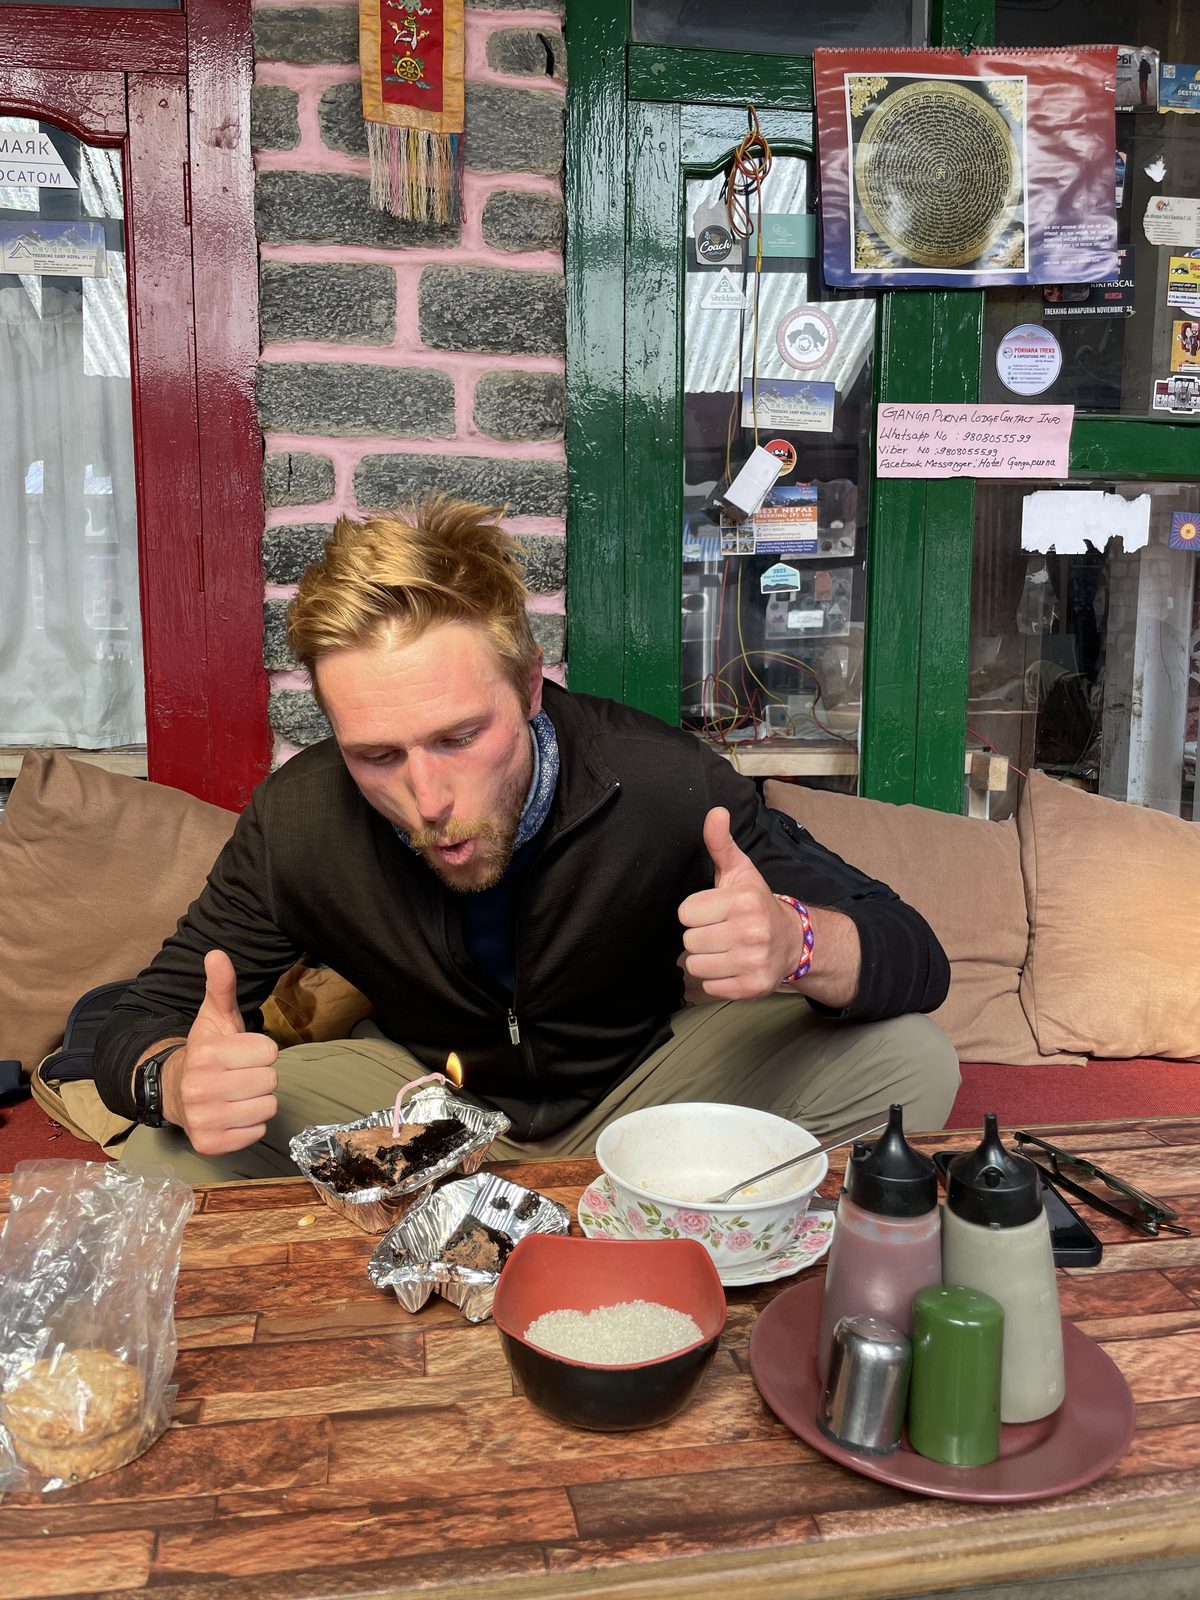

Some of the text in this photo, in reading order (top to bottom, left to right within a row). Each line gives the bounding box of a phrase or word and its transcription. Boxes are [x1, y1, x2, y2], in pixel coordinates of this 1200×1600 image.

[700, 240, 732, 254] Coach
[882, 406, 930, 423] GANGA
[932, 408, 968, 423] PURNA
[970, 410, 999, 426] LODGE
[1000, 410, 1034, 424] CONTACT
[880, 427, 930, 442] Whatsapp
[934, 430, 948, 441] No
[962, 432, 1031, 443] 9808055599
[878, 444, 908, 454] Viber
[917, 446, 930, 454] No
[879, 459, 922, 469] Facebook
[978, 458, 1004, 468] Hotel
[1007, 456, 1056, 471] Gangapurna
